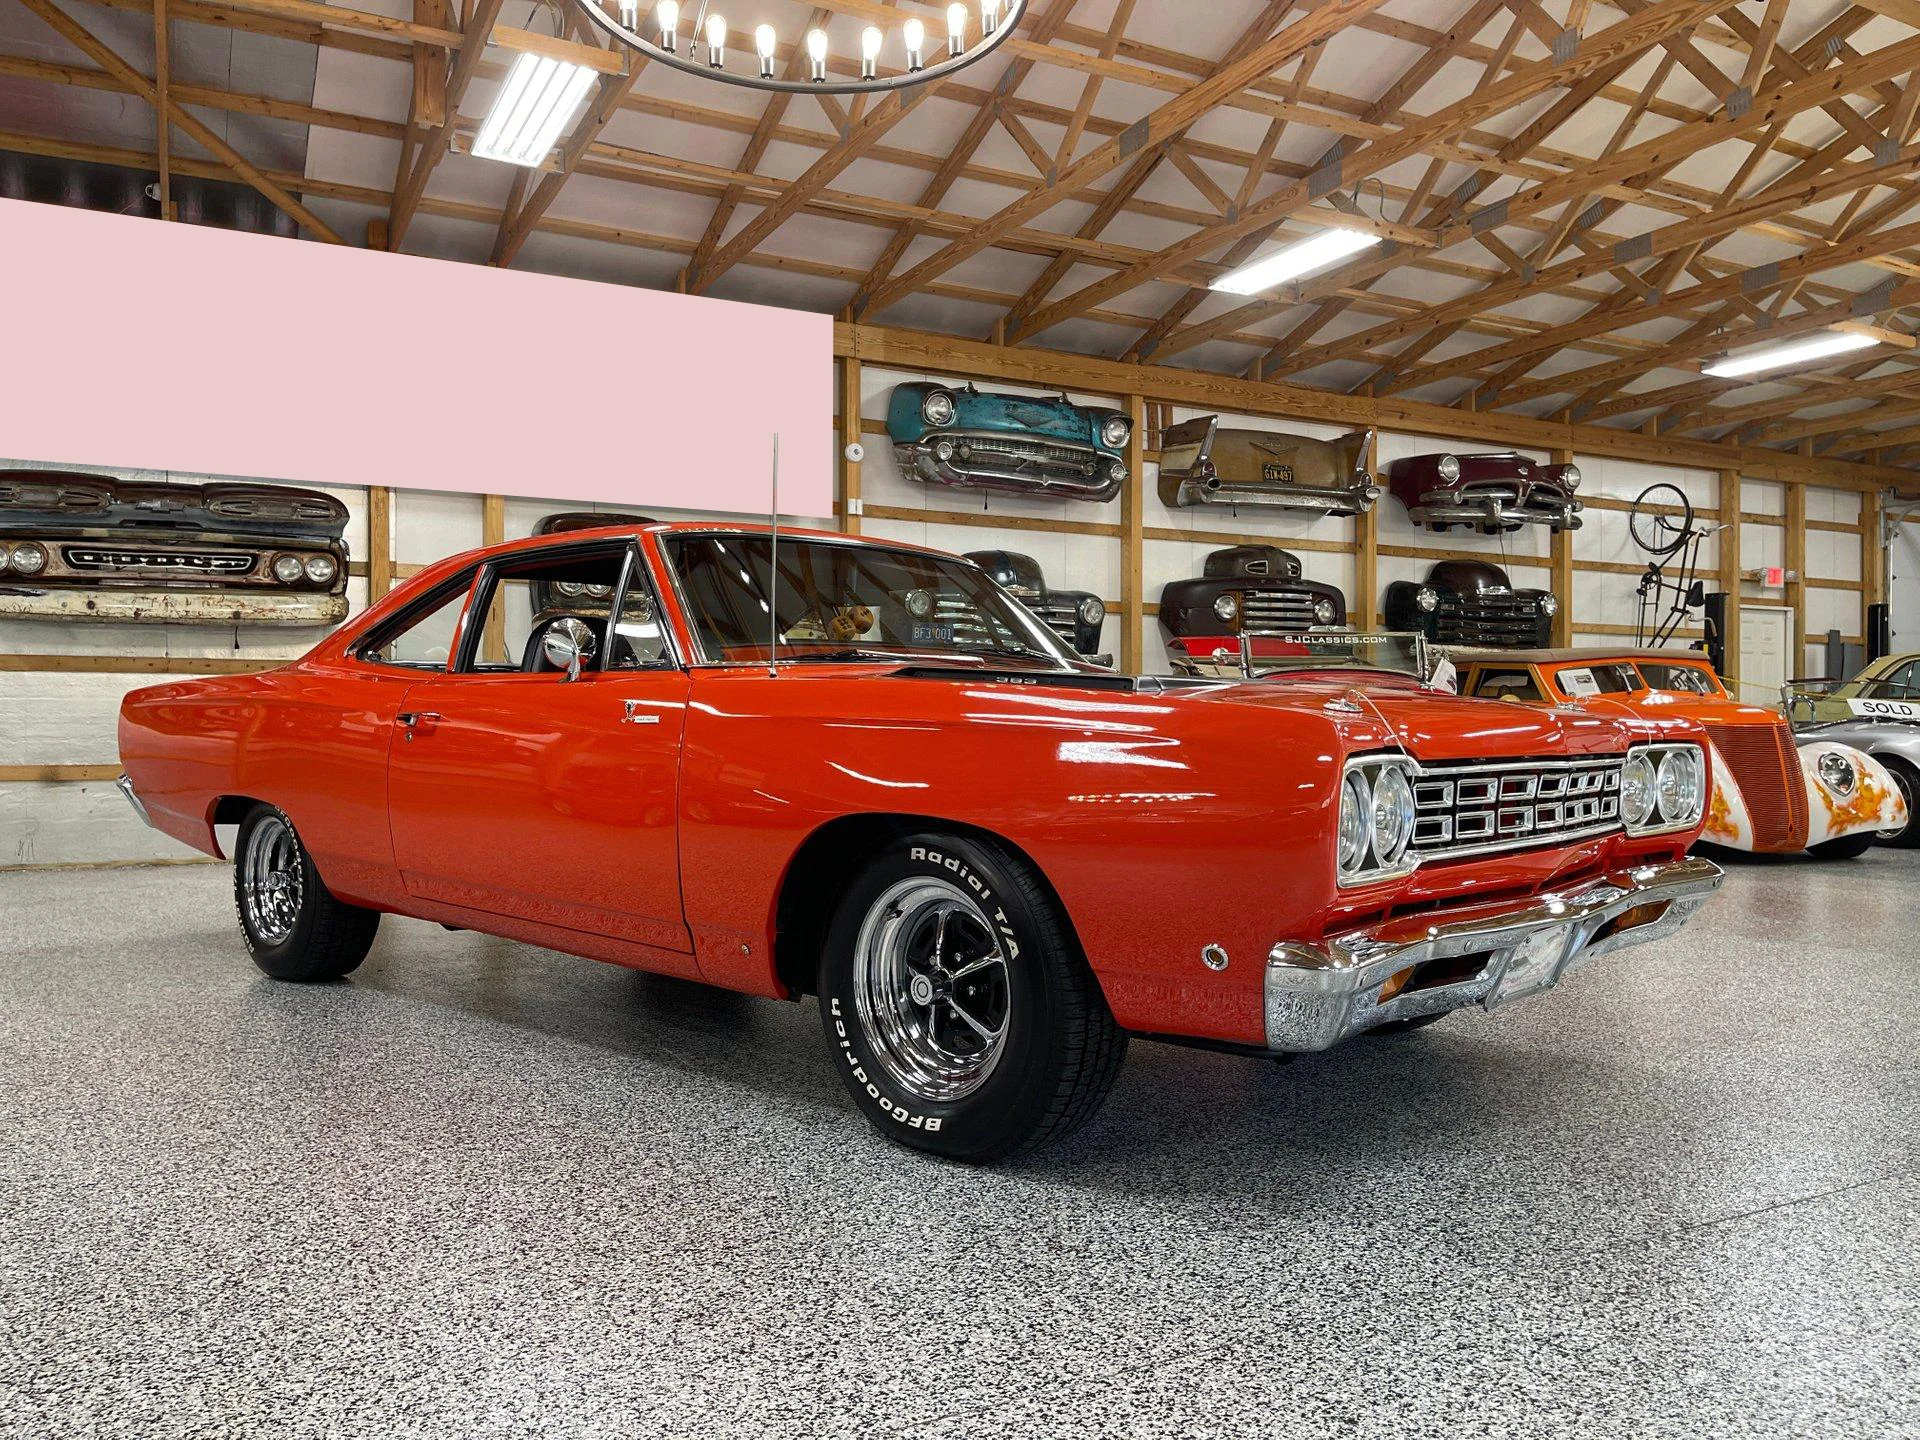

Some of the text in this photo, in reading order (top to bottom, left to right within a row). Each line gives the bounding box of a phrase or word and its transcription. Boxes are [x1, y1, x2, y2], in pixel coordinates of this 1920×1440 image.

[935, 628, 951, 640] 001
[1862, 702, 1913, 716] SOLD
[911, 848, 1020, 960] Radial T/A
[831, 998, 942, 1132] BFGoodrich
